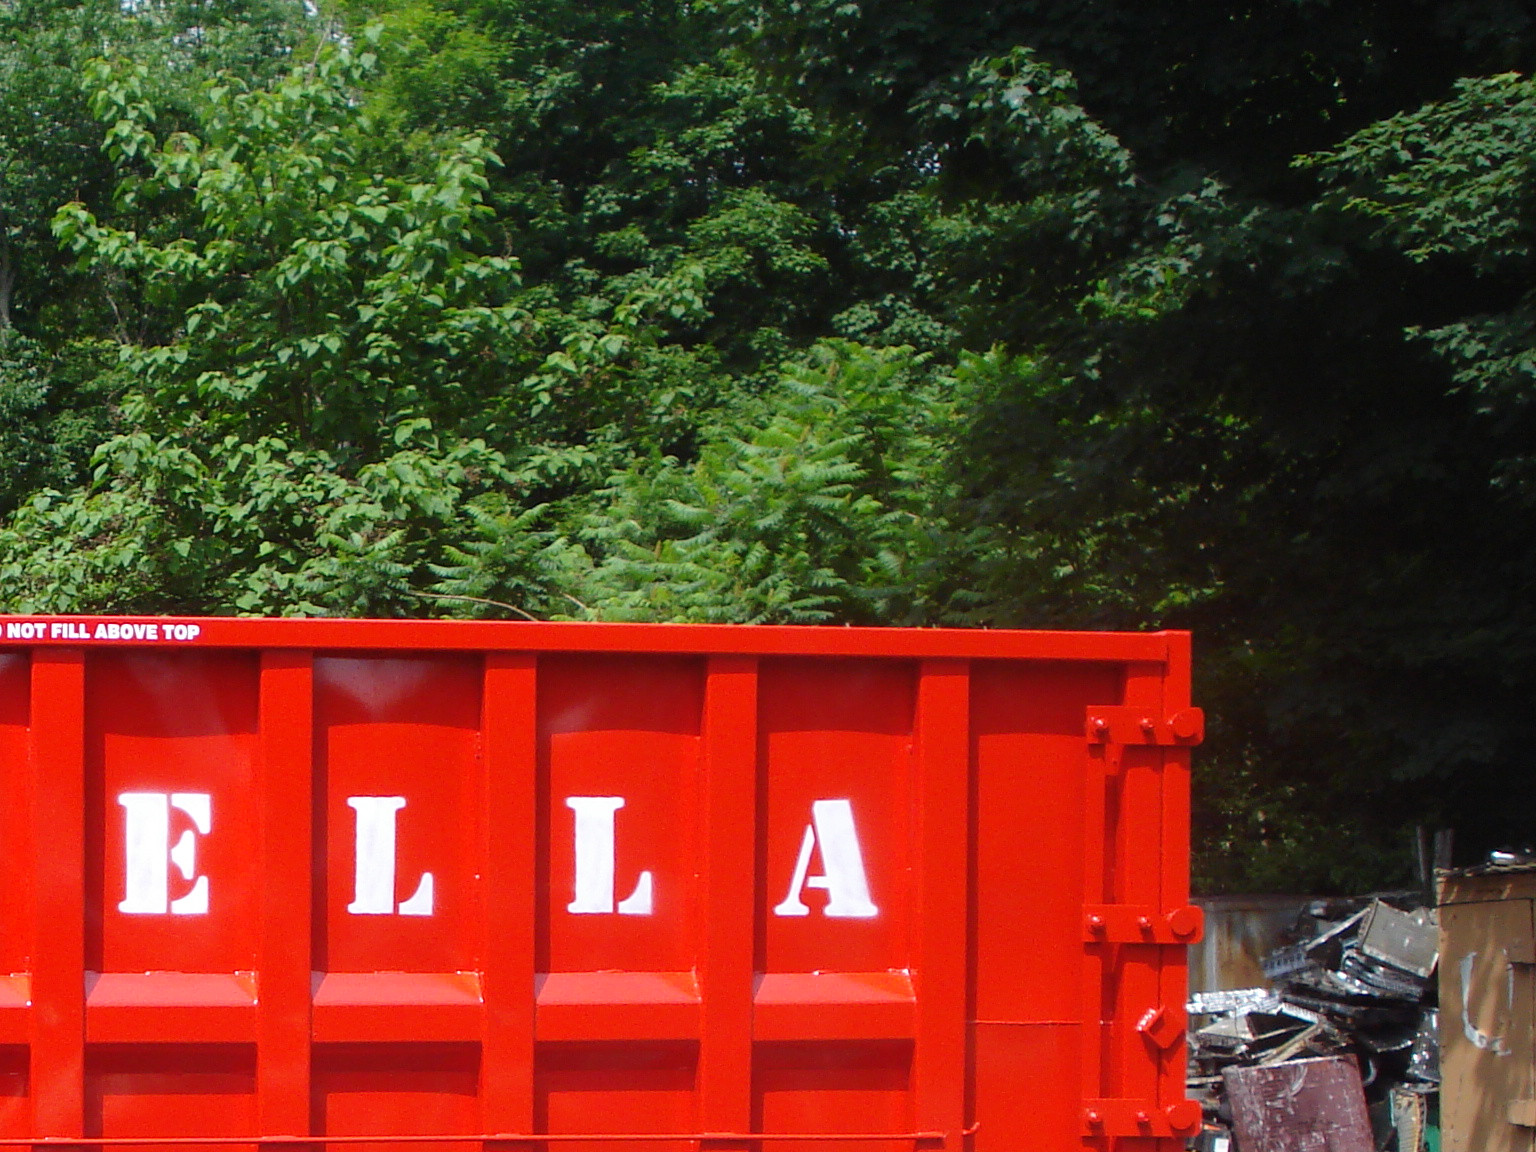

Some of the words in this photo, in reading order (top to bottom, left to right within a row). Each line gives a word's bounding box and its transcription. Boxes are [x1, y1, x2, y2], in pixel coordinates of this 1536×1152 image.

[7, 623, 47, 639] NOT
[51, 623, 91, 640] FILL
[94, 624, 159, 641] ABOVE
[162, 625, 201, 641] TOP
